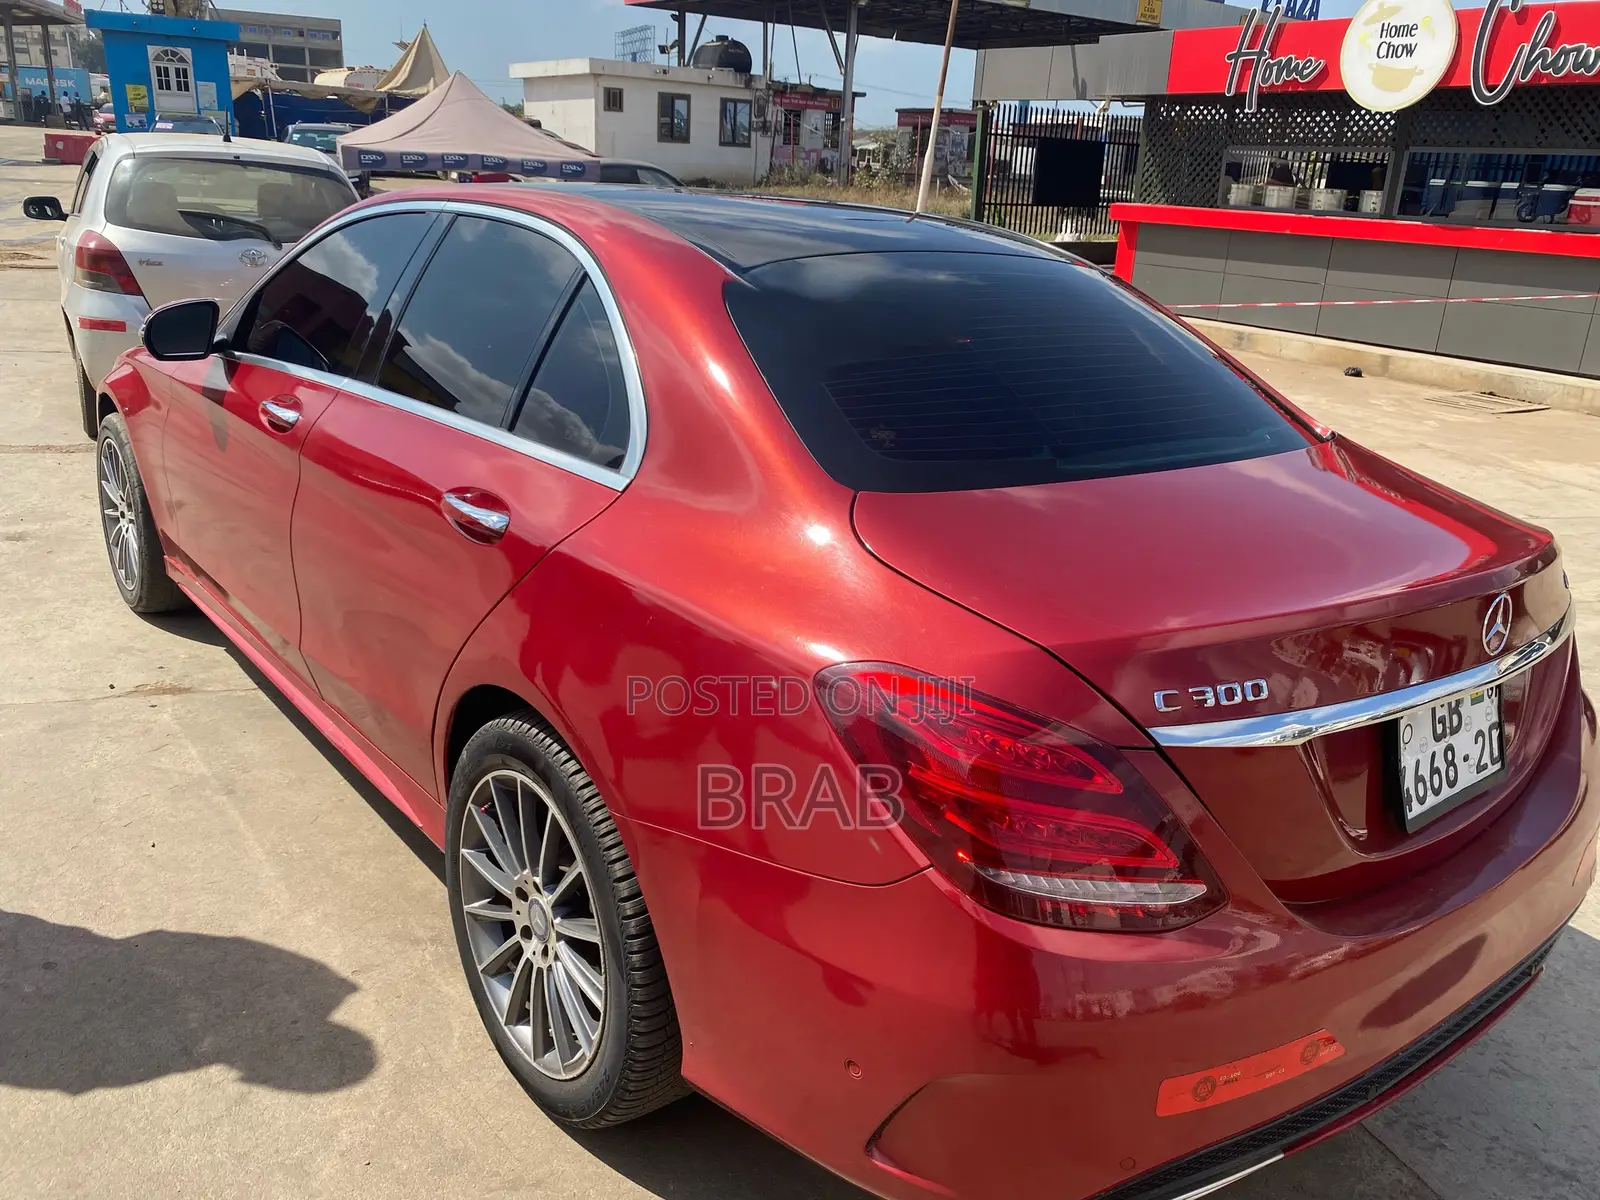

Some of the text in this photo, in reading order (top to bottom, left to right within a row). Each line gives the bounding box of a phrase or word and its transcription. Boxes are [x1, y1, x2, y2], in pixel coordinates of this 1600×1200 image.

[1379, 22, 1419, 39] Home
[1225, 0, 1600, 113] Home Chow
[1376, 41, 1418, 59] Chow
[1153, 678, 1269, 712] C 300
[1431, 698, 1463, 743] GB
